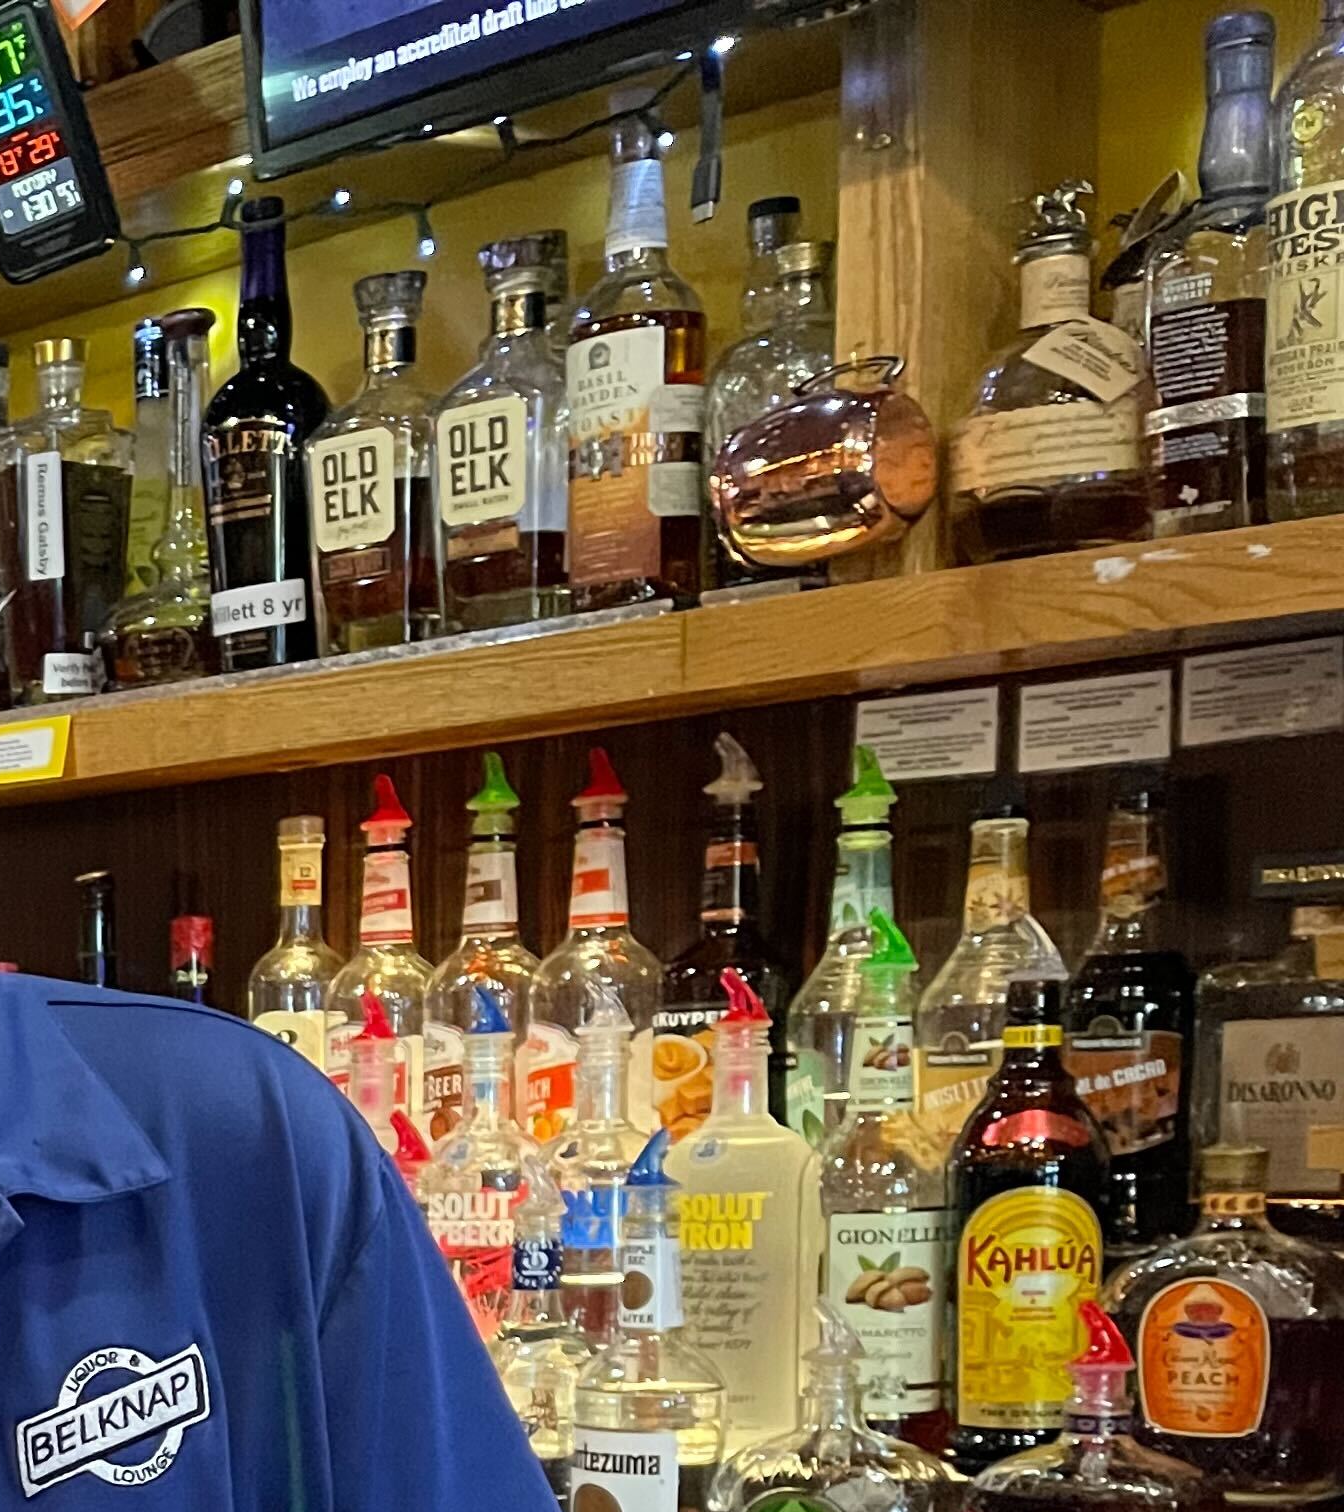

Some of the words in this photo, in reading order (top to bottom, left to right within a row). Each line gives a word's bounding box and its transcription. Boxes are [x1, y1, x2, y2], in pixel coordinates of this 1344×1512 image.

[318, 56, 375, 91] employ
[374, 49, 396, 75] an
[396, 13, 481, 67] accredited
[481, 1, 525, 36] draft
[448, 415, 510, 460] OLD
[322, 444, 378, 488] OLD
[450, 452, 512, 496] ELK
[34, 462, 50, 519] Remus
[323, 481, 382, 523] ELK
[262, 597, 275, 616] 8
[281, 597, 303, 618] yr
[1226, 1079, 1337, 1104] DISARONNO
[967, 1234, 1097, 1289] KAHLÚA
[66, 1350, 119, 1393] LIQUOR
[1166, 1369, 1240, 1386] PEACH
[31, 1371, 191, 1467] BELKNAP
[112, 1446, 175, 1483] LOUNGE
